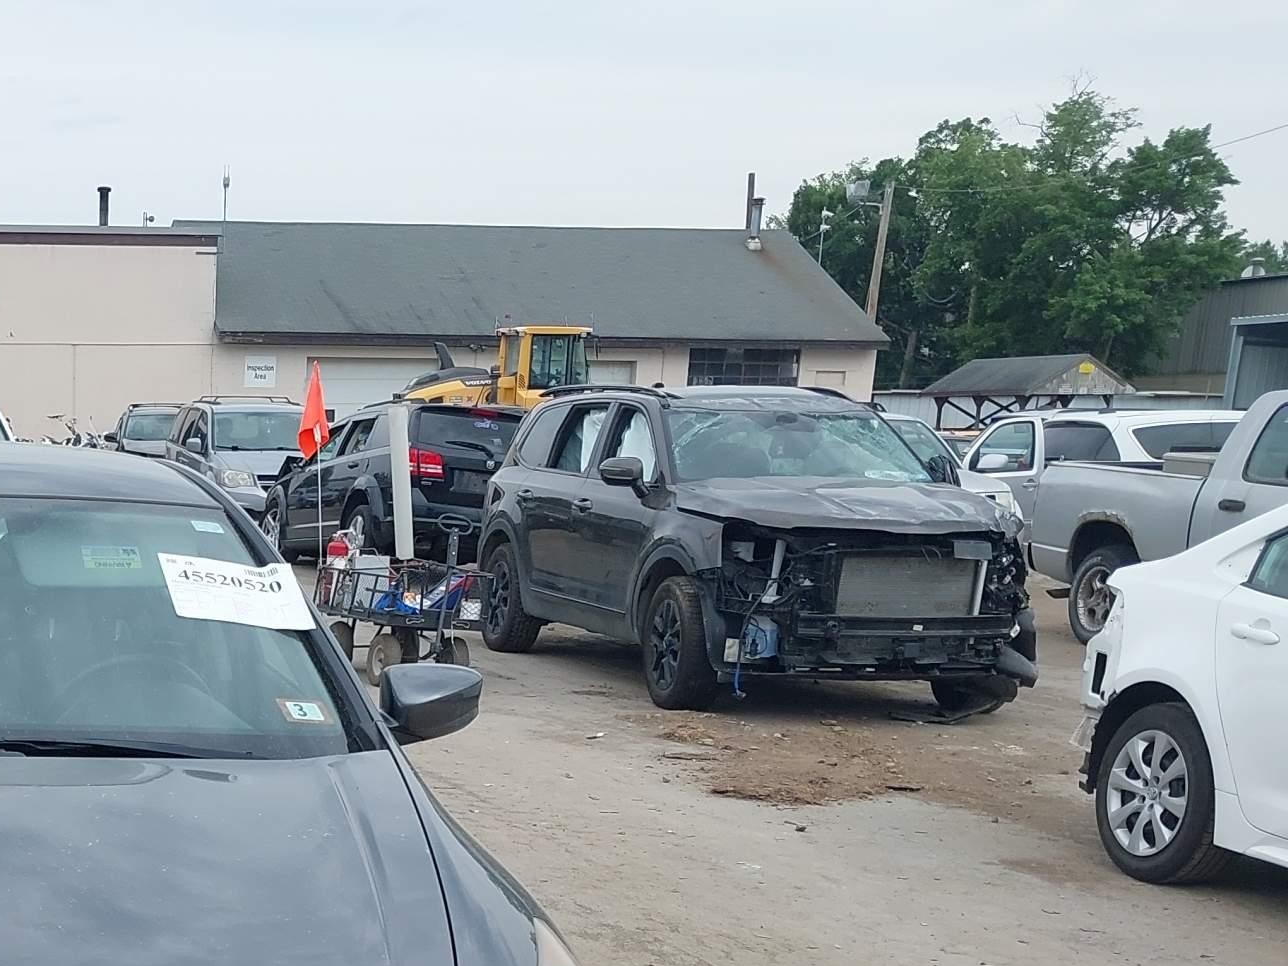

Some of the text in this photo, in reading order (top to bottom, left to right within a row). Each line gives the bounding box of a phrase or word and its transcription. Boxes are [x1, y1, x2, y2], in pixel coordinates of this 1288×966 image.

[247, 364, 274, 372] Inspection
[178, 569, 282, 593] 45520520
[293, 704, 308, 717] 3
